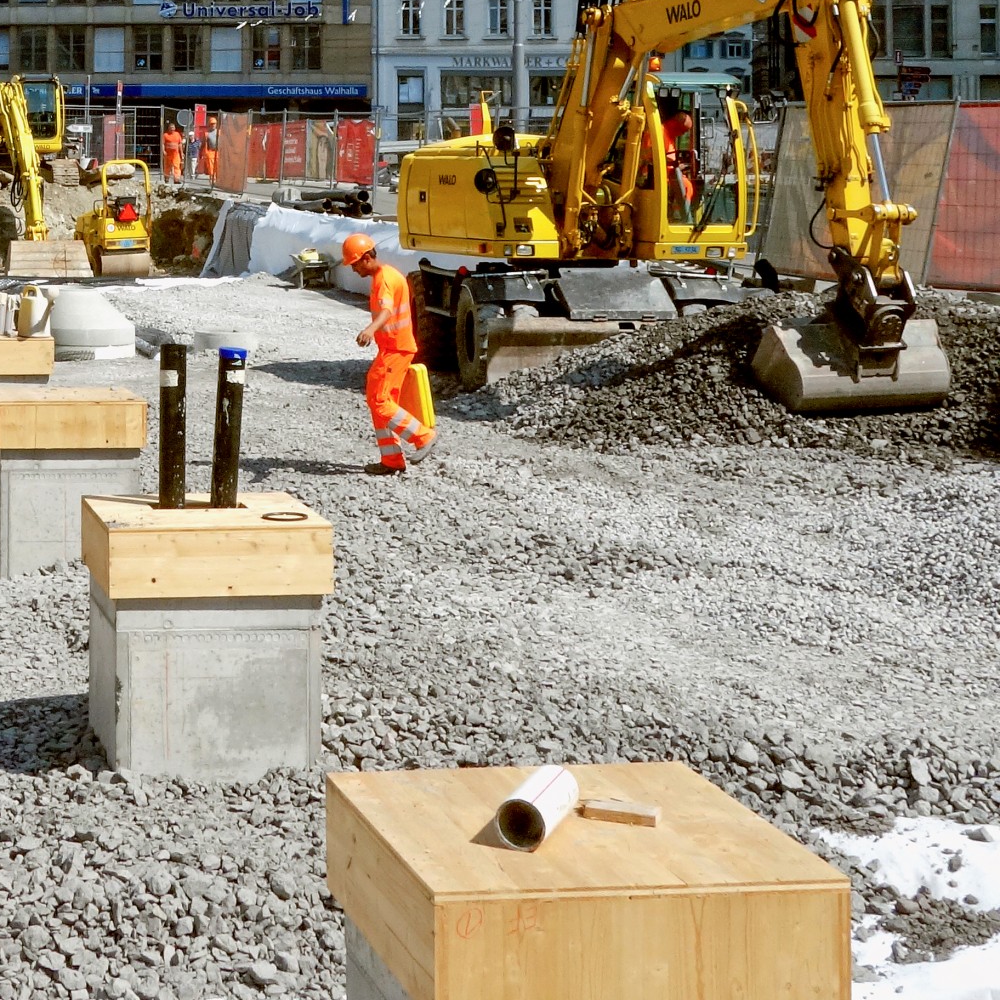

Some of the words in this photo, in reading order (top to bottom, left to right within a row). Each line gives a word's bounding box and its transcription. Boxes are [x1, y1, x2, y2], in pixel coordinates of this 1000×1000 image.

[182, 1, 319, 18] Universal-Job
[665, 0, 701, 24] WALO
[453, 56, 541, 69] MARKWADER
[267, 86, 323, 95] Geschäftshaus
[324, 86, 359, 95] Walhalla
[438, 174, 457, 186] WALO
[117, 224, 136, 232] WALO
